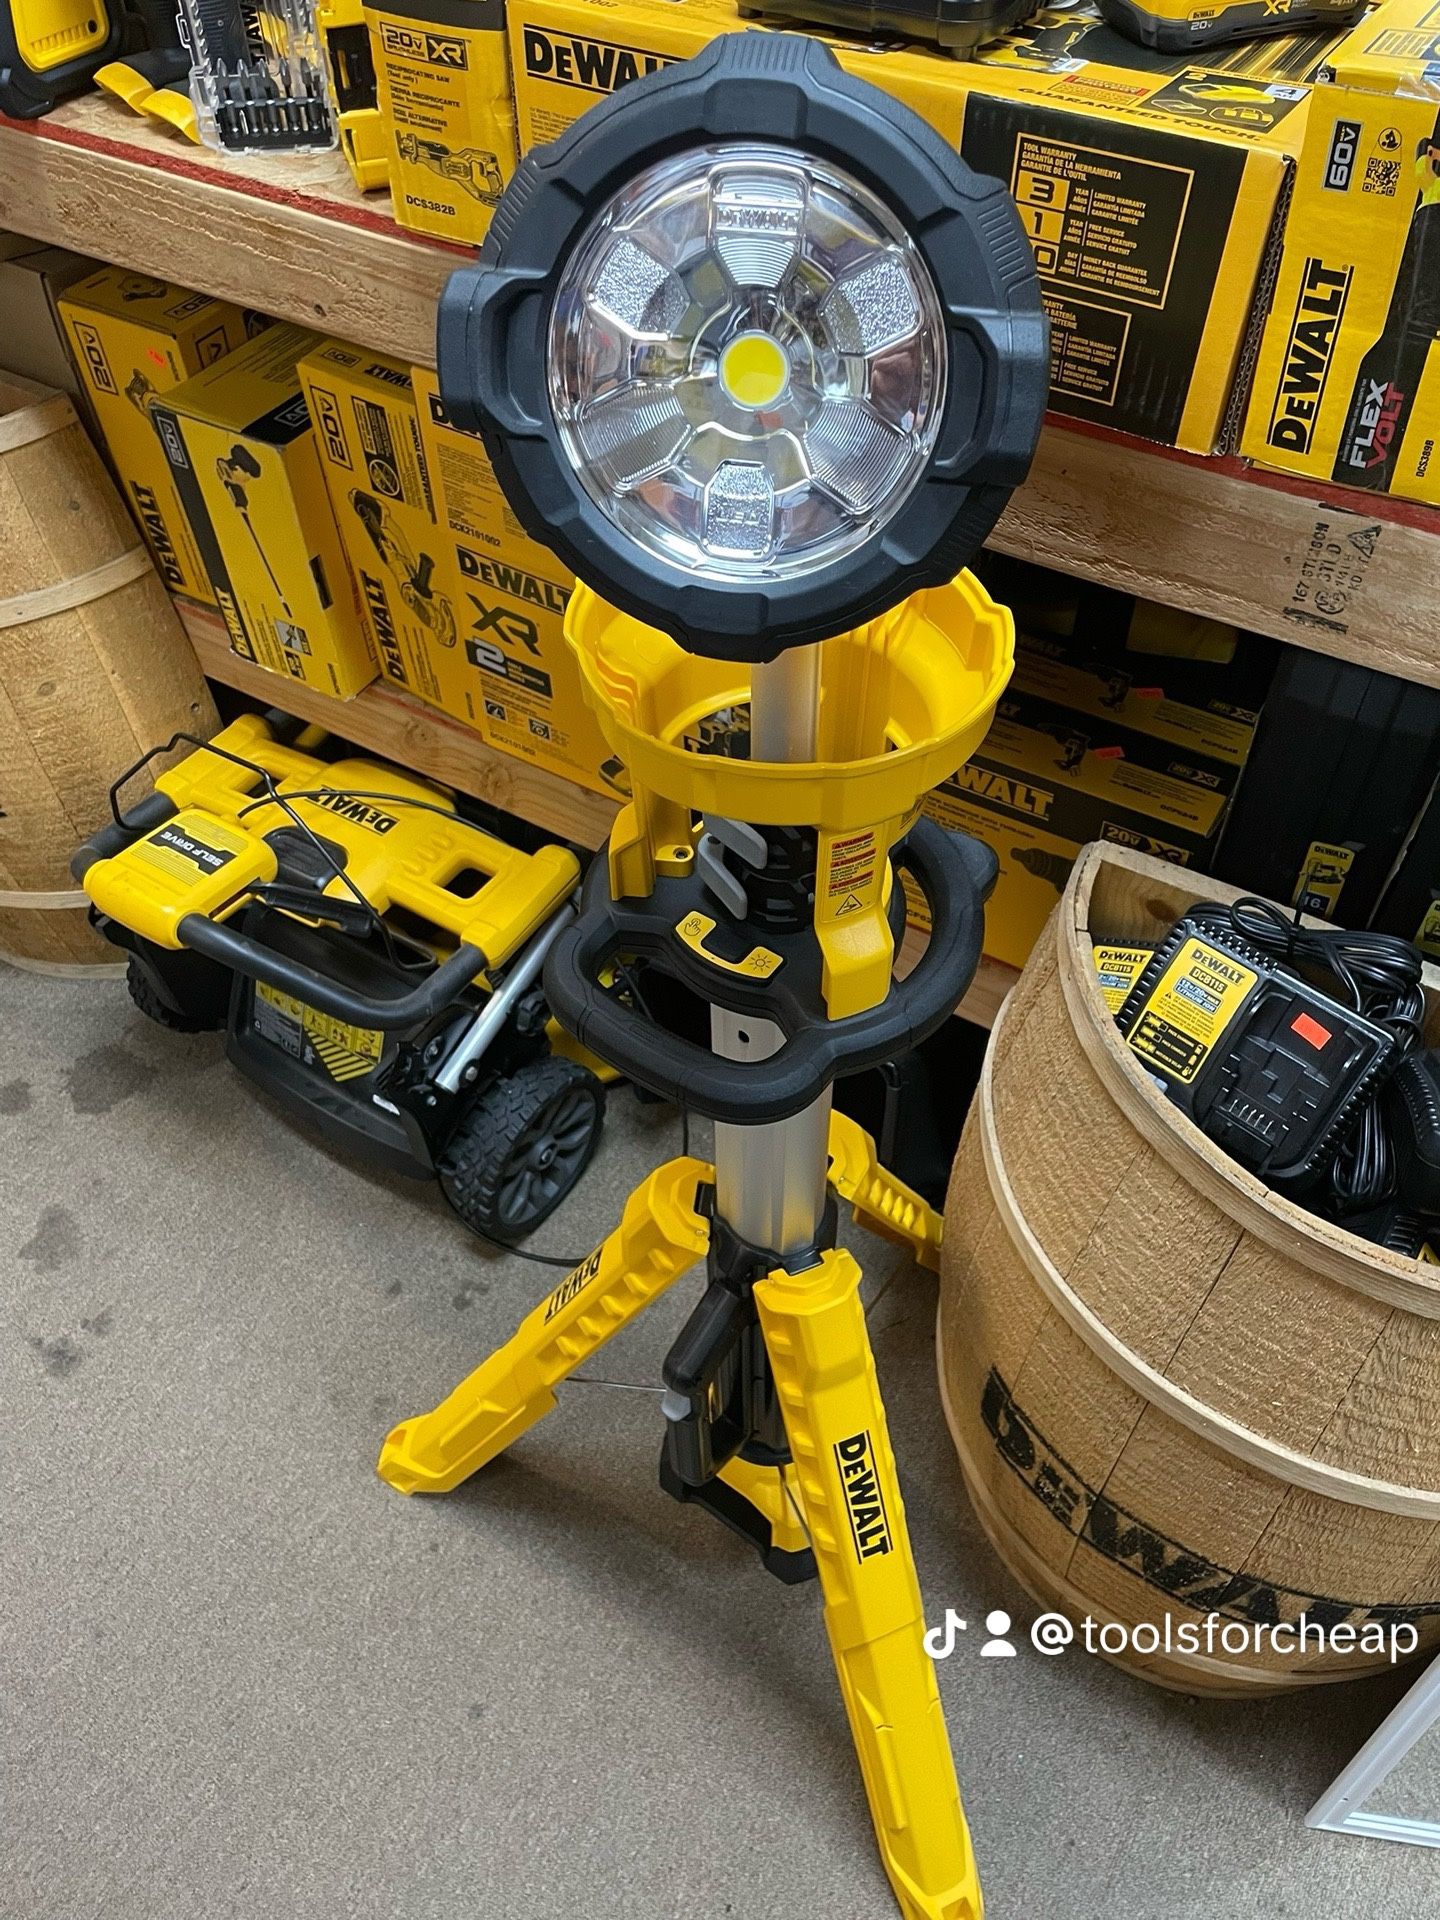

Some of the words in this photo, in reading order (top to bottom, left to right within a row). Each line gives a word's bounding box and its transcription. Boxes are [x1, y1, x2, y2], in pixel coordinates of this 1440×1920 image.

[1193, 10, 1215, 18] DEWALT
[428, 39, 463, 64] XR
[386, 62, 434, 80] RECIPROCATING
[436, 75, 450, 83] SAW
[1018, 87, 1169, 122] GUARANTEED
[1023, 142, 1039, 154] TOOL
[1040, 145, 1077, 160] WARRANTY
[1329, 130, 1355, 188] 60V
[1021, 160, 1052, 173] GARANTIE
[1053, 166, 1062, 175] DE
[1055, 158, 1064, 167] DE
[1065, 160, 1074, 169] LA
[1075, 162, 1122, 180] HERRAMIENTA
[1029, 177, 1055, 203] 3
[1075, 188, 1089, 196] YEAR
[1094, 192, 1116, 202] LIMITED
[1116, 196, 1146, 209] WARRANTY
[406, 195, 456, 216] DCS382B
[1119, 205, 1145, 218] LIMITADA
[1034, 212, 1043, 234] 1
[1070, 219, 1084, 228] YEAR
[1088, 223, 1102, 233] FREE
[1103, 227, 1125, 237] SERVICE
[1086, 240, 1108, 251] SERVICE
[1088, 232, 1111, 243] SERVICIO
[1111, 238, 1137, 249] GRATUITO
[1083, 255, 1101, 265] MONEY
[1102, 259, 1116, 268] BACK
[1117, 262, 1148, 276] GUARANTEE
[1108, 269, 1115, 277] DE
[1271, 258, 1350, 455] DEWALT
[319, 396, 347, 463] 20V
[1350, 378, 1390, 469] FLEX
[1365, 381, 1405, 469] VOLT
[1415, 439, 1435, 478] DCS389B
[134, 485, 185, 587] DEWALT
[1292, 581, 1310, 602] 167
[363, 573, 407, 685] DEWALT
[465, 592, 543, 657] XR
[473, 636, 507, 674] 2
[160, 831, 199, 852] DRIVE
[192, 848, 224, 867] SELF
[1100, 951, 1146, 963] DEWALT
[1103, 963, 1132, 972] DCB115
[1191, 950, 1245, 984] DEWALT
[1192, 970, 1224, 991] DCB115
[1176, 986, 1202, 1003] LITHIUM
[1202, 1002, 1216, 1011] ION
[547, 1255, 602, 1321] DEWALT
[838, 1432, 889, 1559] DEWALT
